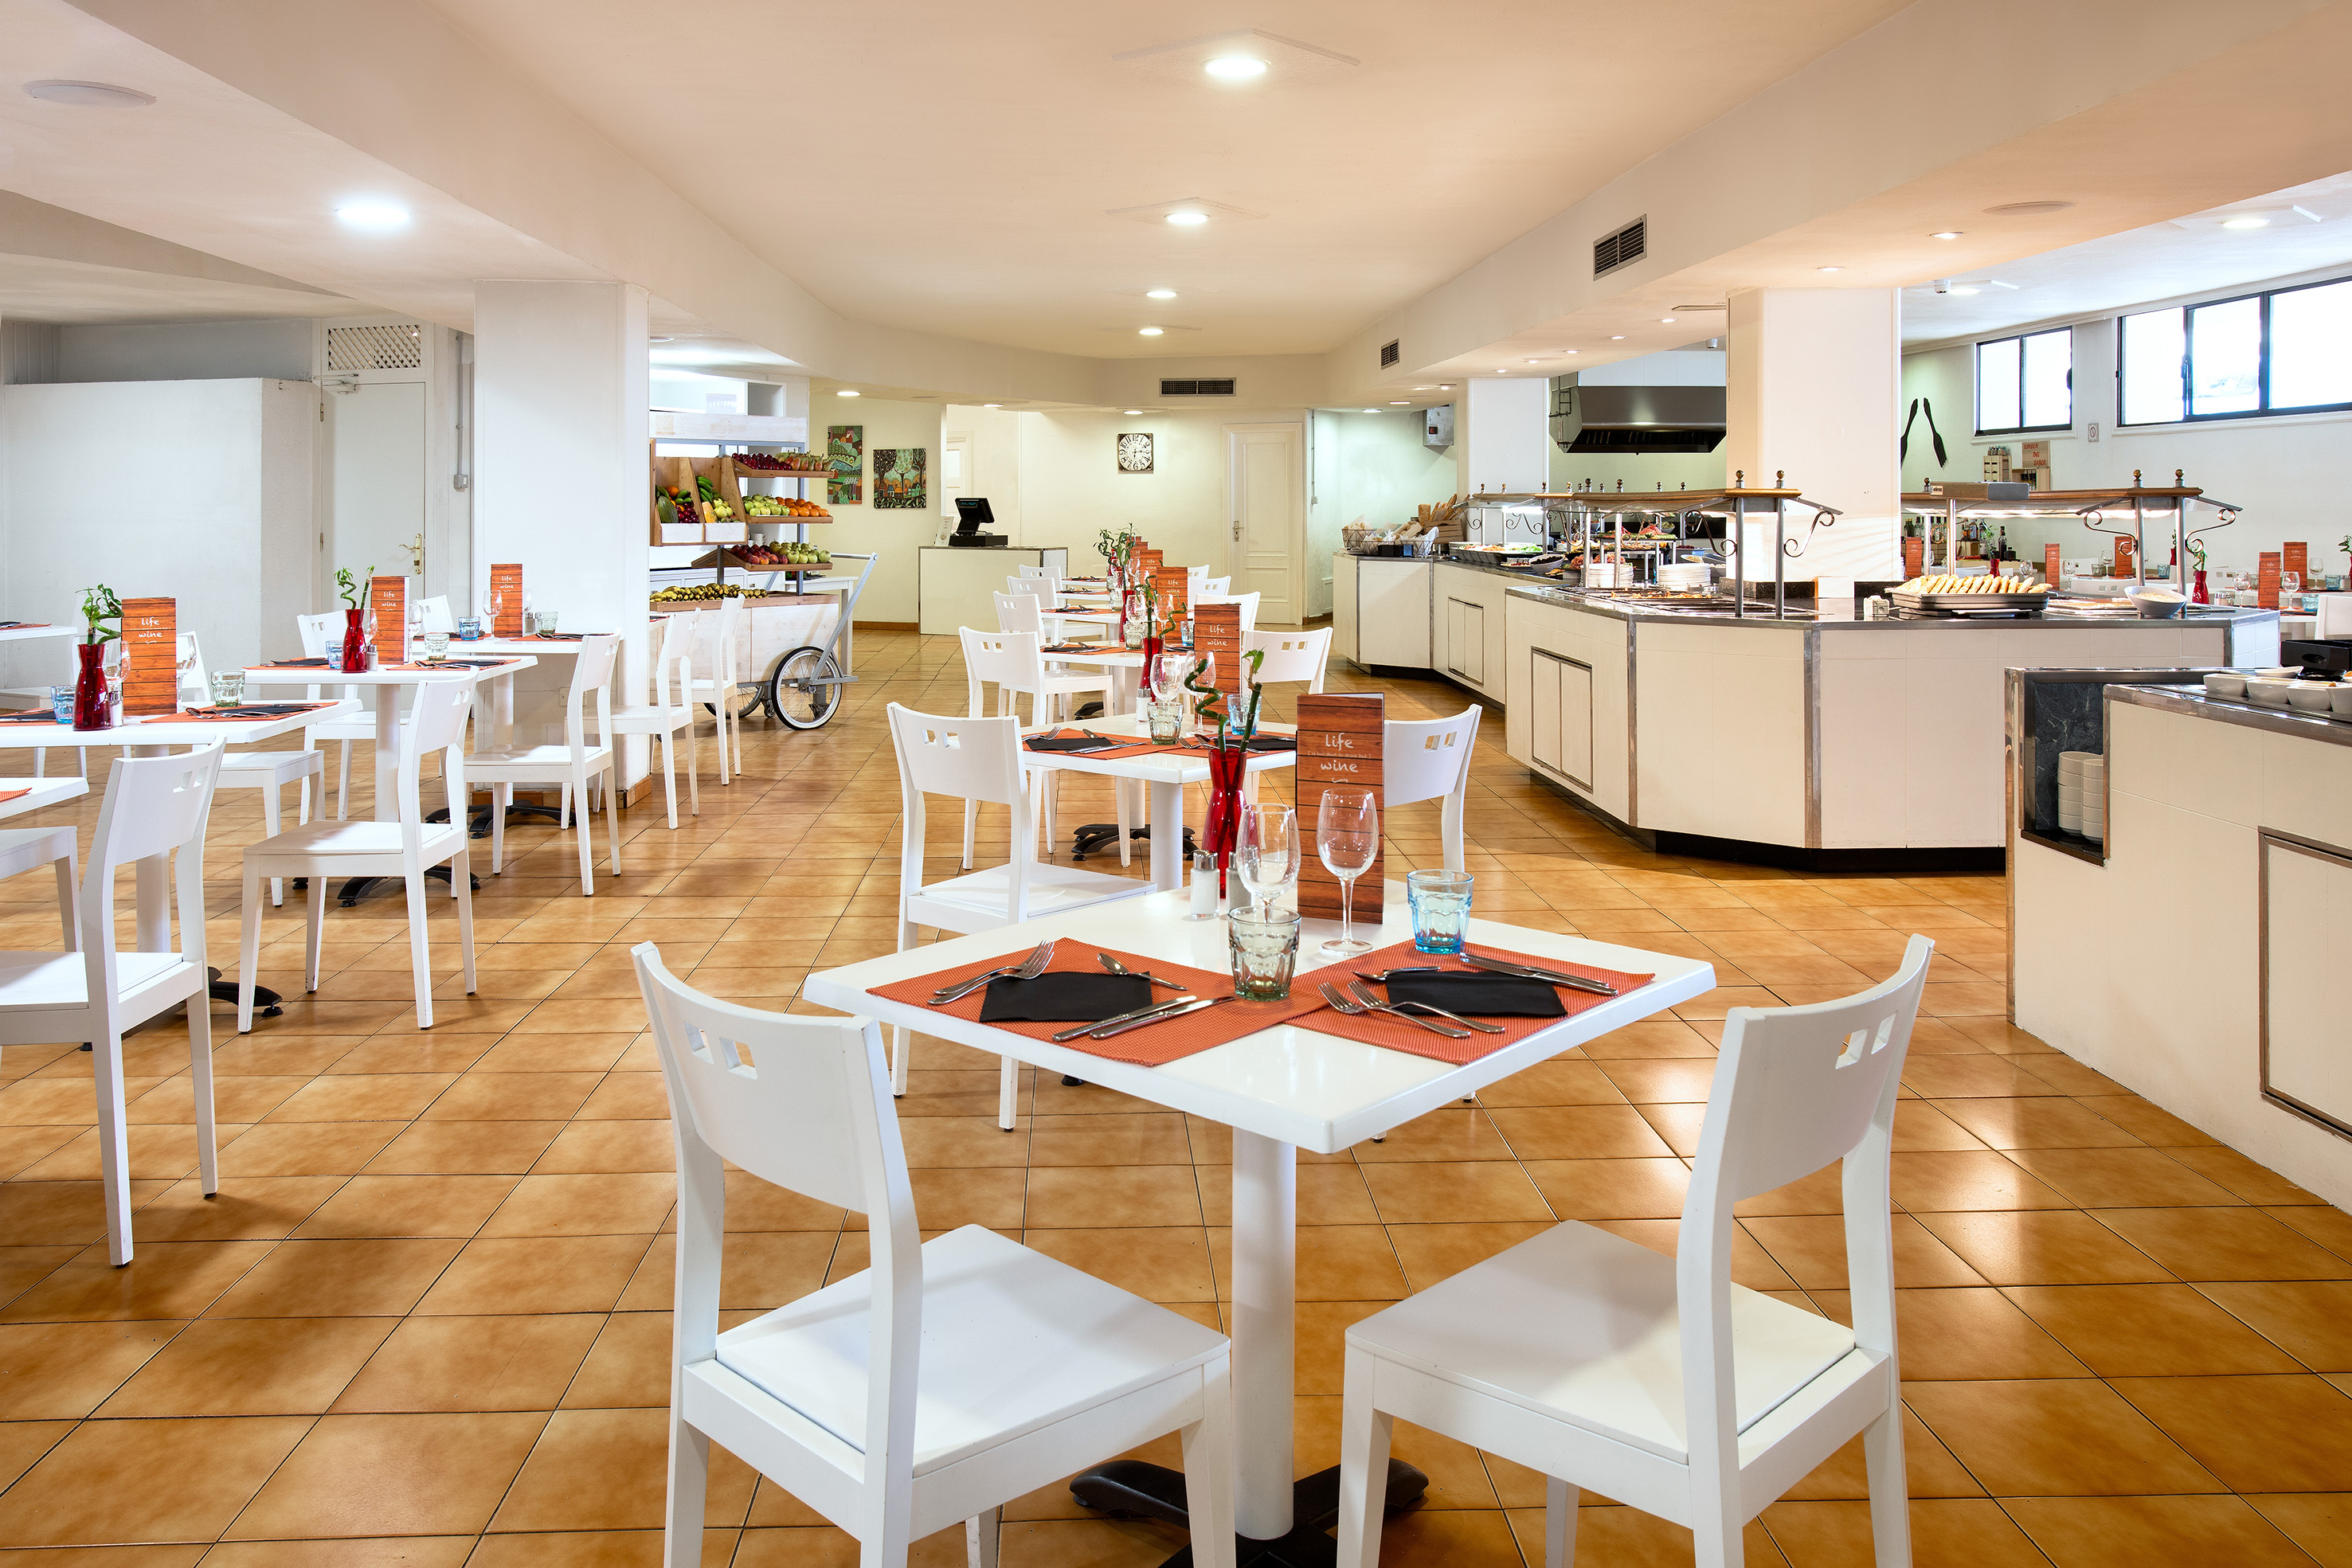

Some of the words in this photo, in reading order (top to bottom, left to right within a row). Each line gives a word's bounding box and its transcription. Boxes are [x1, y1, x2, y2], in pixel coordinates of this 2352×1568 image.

[141, 616, 159, 627] life
[1210, 624, 1225, 635] life
[1325, 732, 1354, 751] life
[1321, 759, 1358, 772] wine
